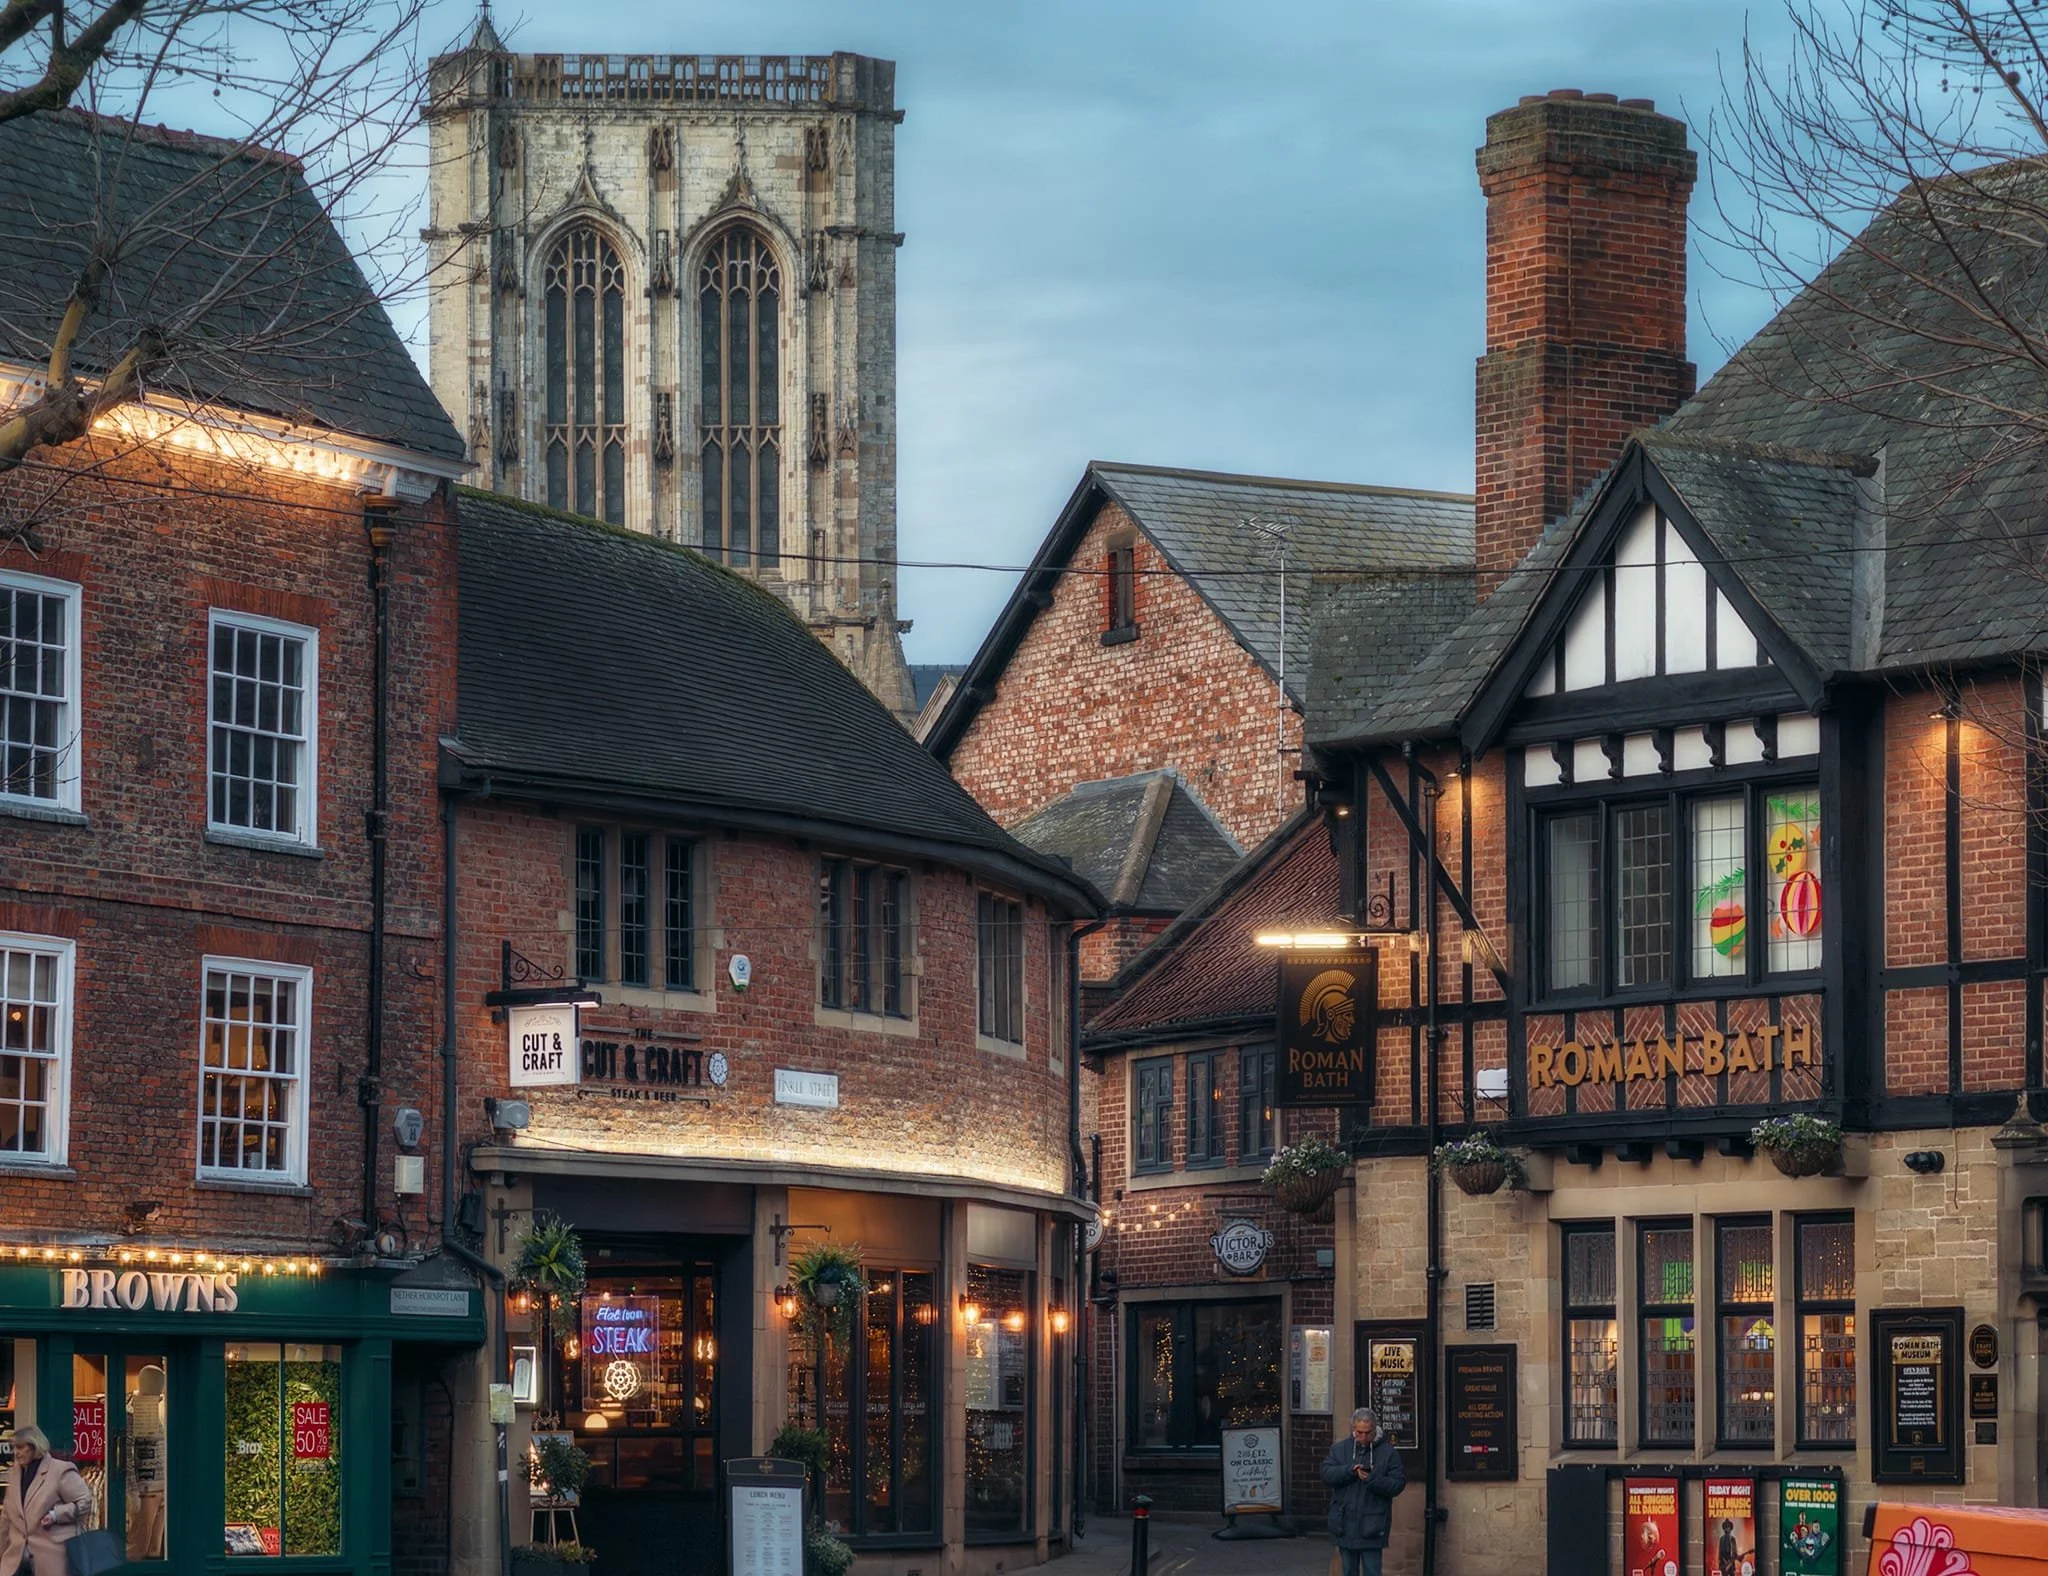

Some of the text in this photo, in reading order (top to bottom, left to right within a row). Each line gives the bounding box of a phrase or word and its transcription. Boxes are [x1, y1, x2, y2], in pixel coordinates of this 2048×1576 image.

[635, 1028, 653, 1041] THE
[523, 1032, 562, 1052] CUT &
[522, 1052, 563, 1071] CRAFT
[1288, 1047, 1365, 1074] ROMAN
[1530, 1023, 1812, 1089] ROMAN BATH
[582, 1040, 703, 1087] CUT & CRAFT
[1303, 1071, 1349, 1088] BATH
[611, 1088, 640, 1100] STEAK
[654, 1091, 677, 1102] BEER
[810, 1080, 836, 1098] STREET
[1211, 1236, 1257, 1255] VICTOR
[1233, 1250, 1254, 1262] BAR
[60, 1268, 239, 1313] BROWNS
[393, 1290, 418, 1300] NETHER
[592, 1326, 648, 1354] STEAK
[1893, 1341, 1940, 1350] ROMAN BATH
[1384, 1346, 1401, 1357] LIVE
[1901, 1350, 1931, 1359] MUSEUM
[1380, 1359, 1405, 1369] MUSIC
[74, 1408, 102, 1426] SALE
[297, 1408, 327, 1425] SALE
[238, 1440, 262, 1454] Brax
[296, 1429, 328, 1453] 50%
[91, 1447, 102, 1455] OFF
[316, 1445, 327, 1453] OFF
[1230, 1458, 1273, 1467] ON CLASSIC
[1709, 1485, 1751, 1495] FRIDAY NIGHT
[1785, 1489, 1837, 1503] OVER 1000
[1629, 1495, 1675, 1505] ALL SINGING
[1709, 1497, 1752, 1508] LIVE MUSIC
[1629, 1505, 1675, 1514] ALL DANCING
